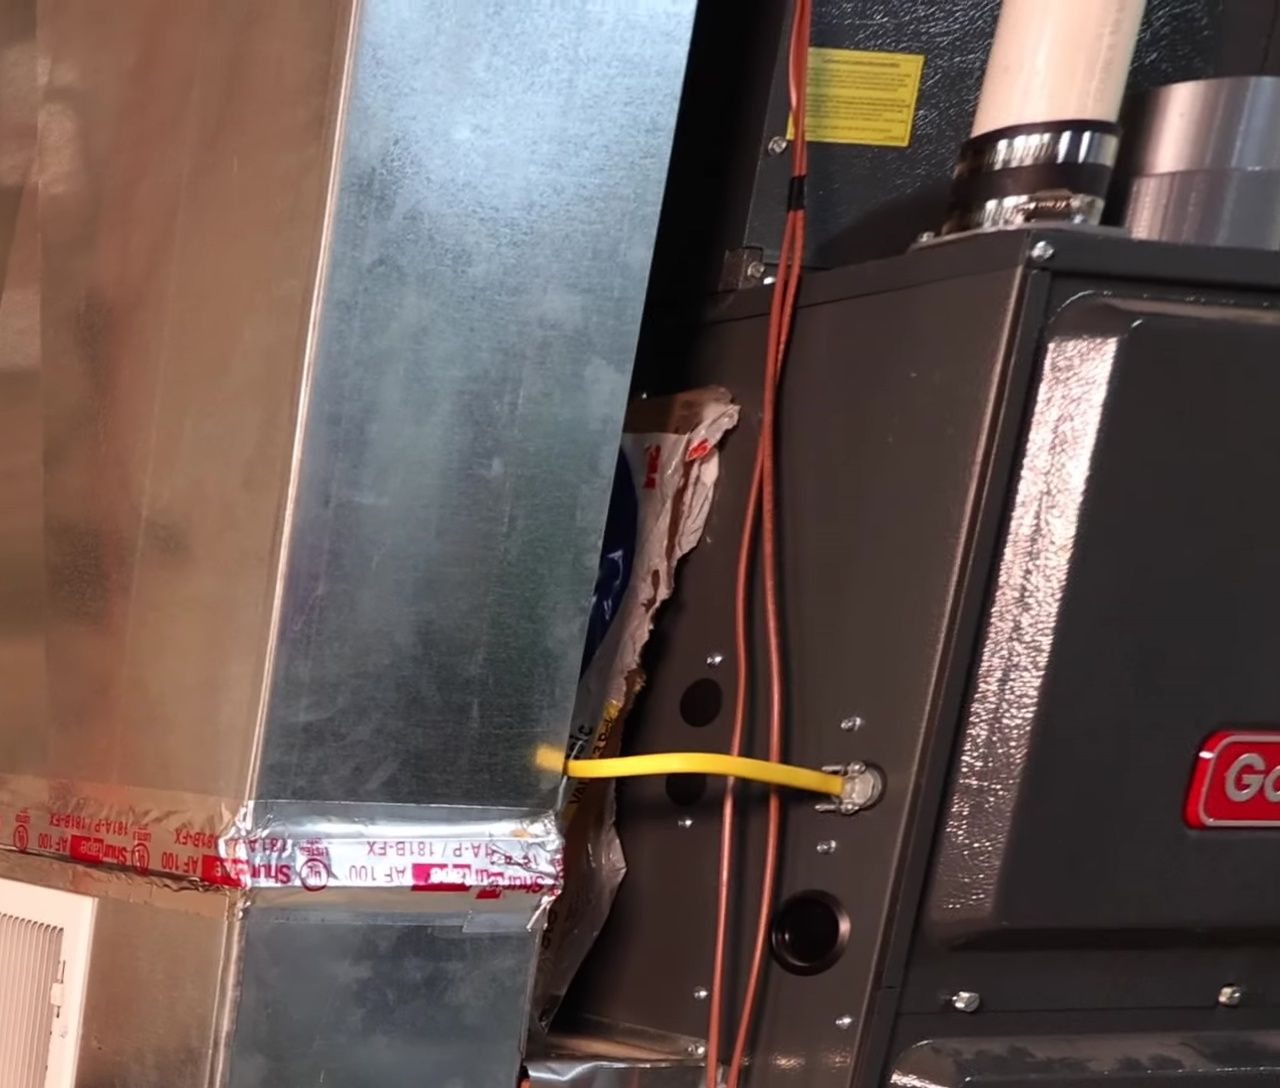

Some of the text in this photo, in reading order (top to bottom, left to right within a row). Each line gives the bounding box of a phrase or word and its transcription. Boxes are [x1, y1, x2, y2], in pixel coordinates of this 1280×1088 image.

[37, 832, 128, 865] Shurtape AF 100
[366, 840, 435, 857] 181B-FX
[161, 851, 180, 871] 100
[186, 856, 199, 874] AF
[348, 864, 376, 882] 100
[385, 864, 407, 883] AF
